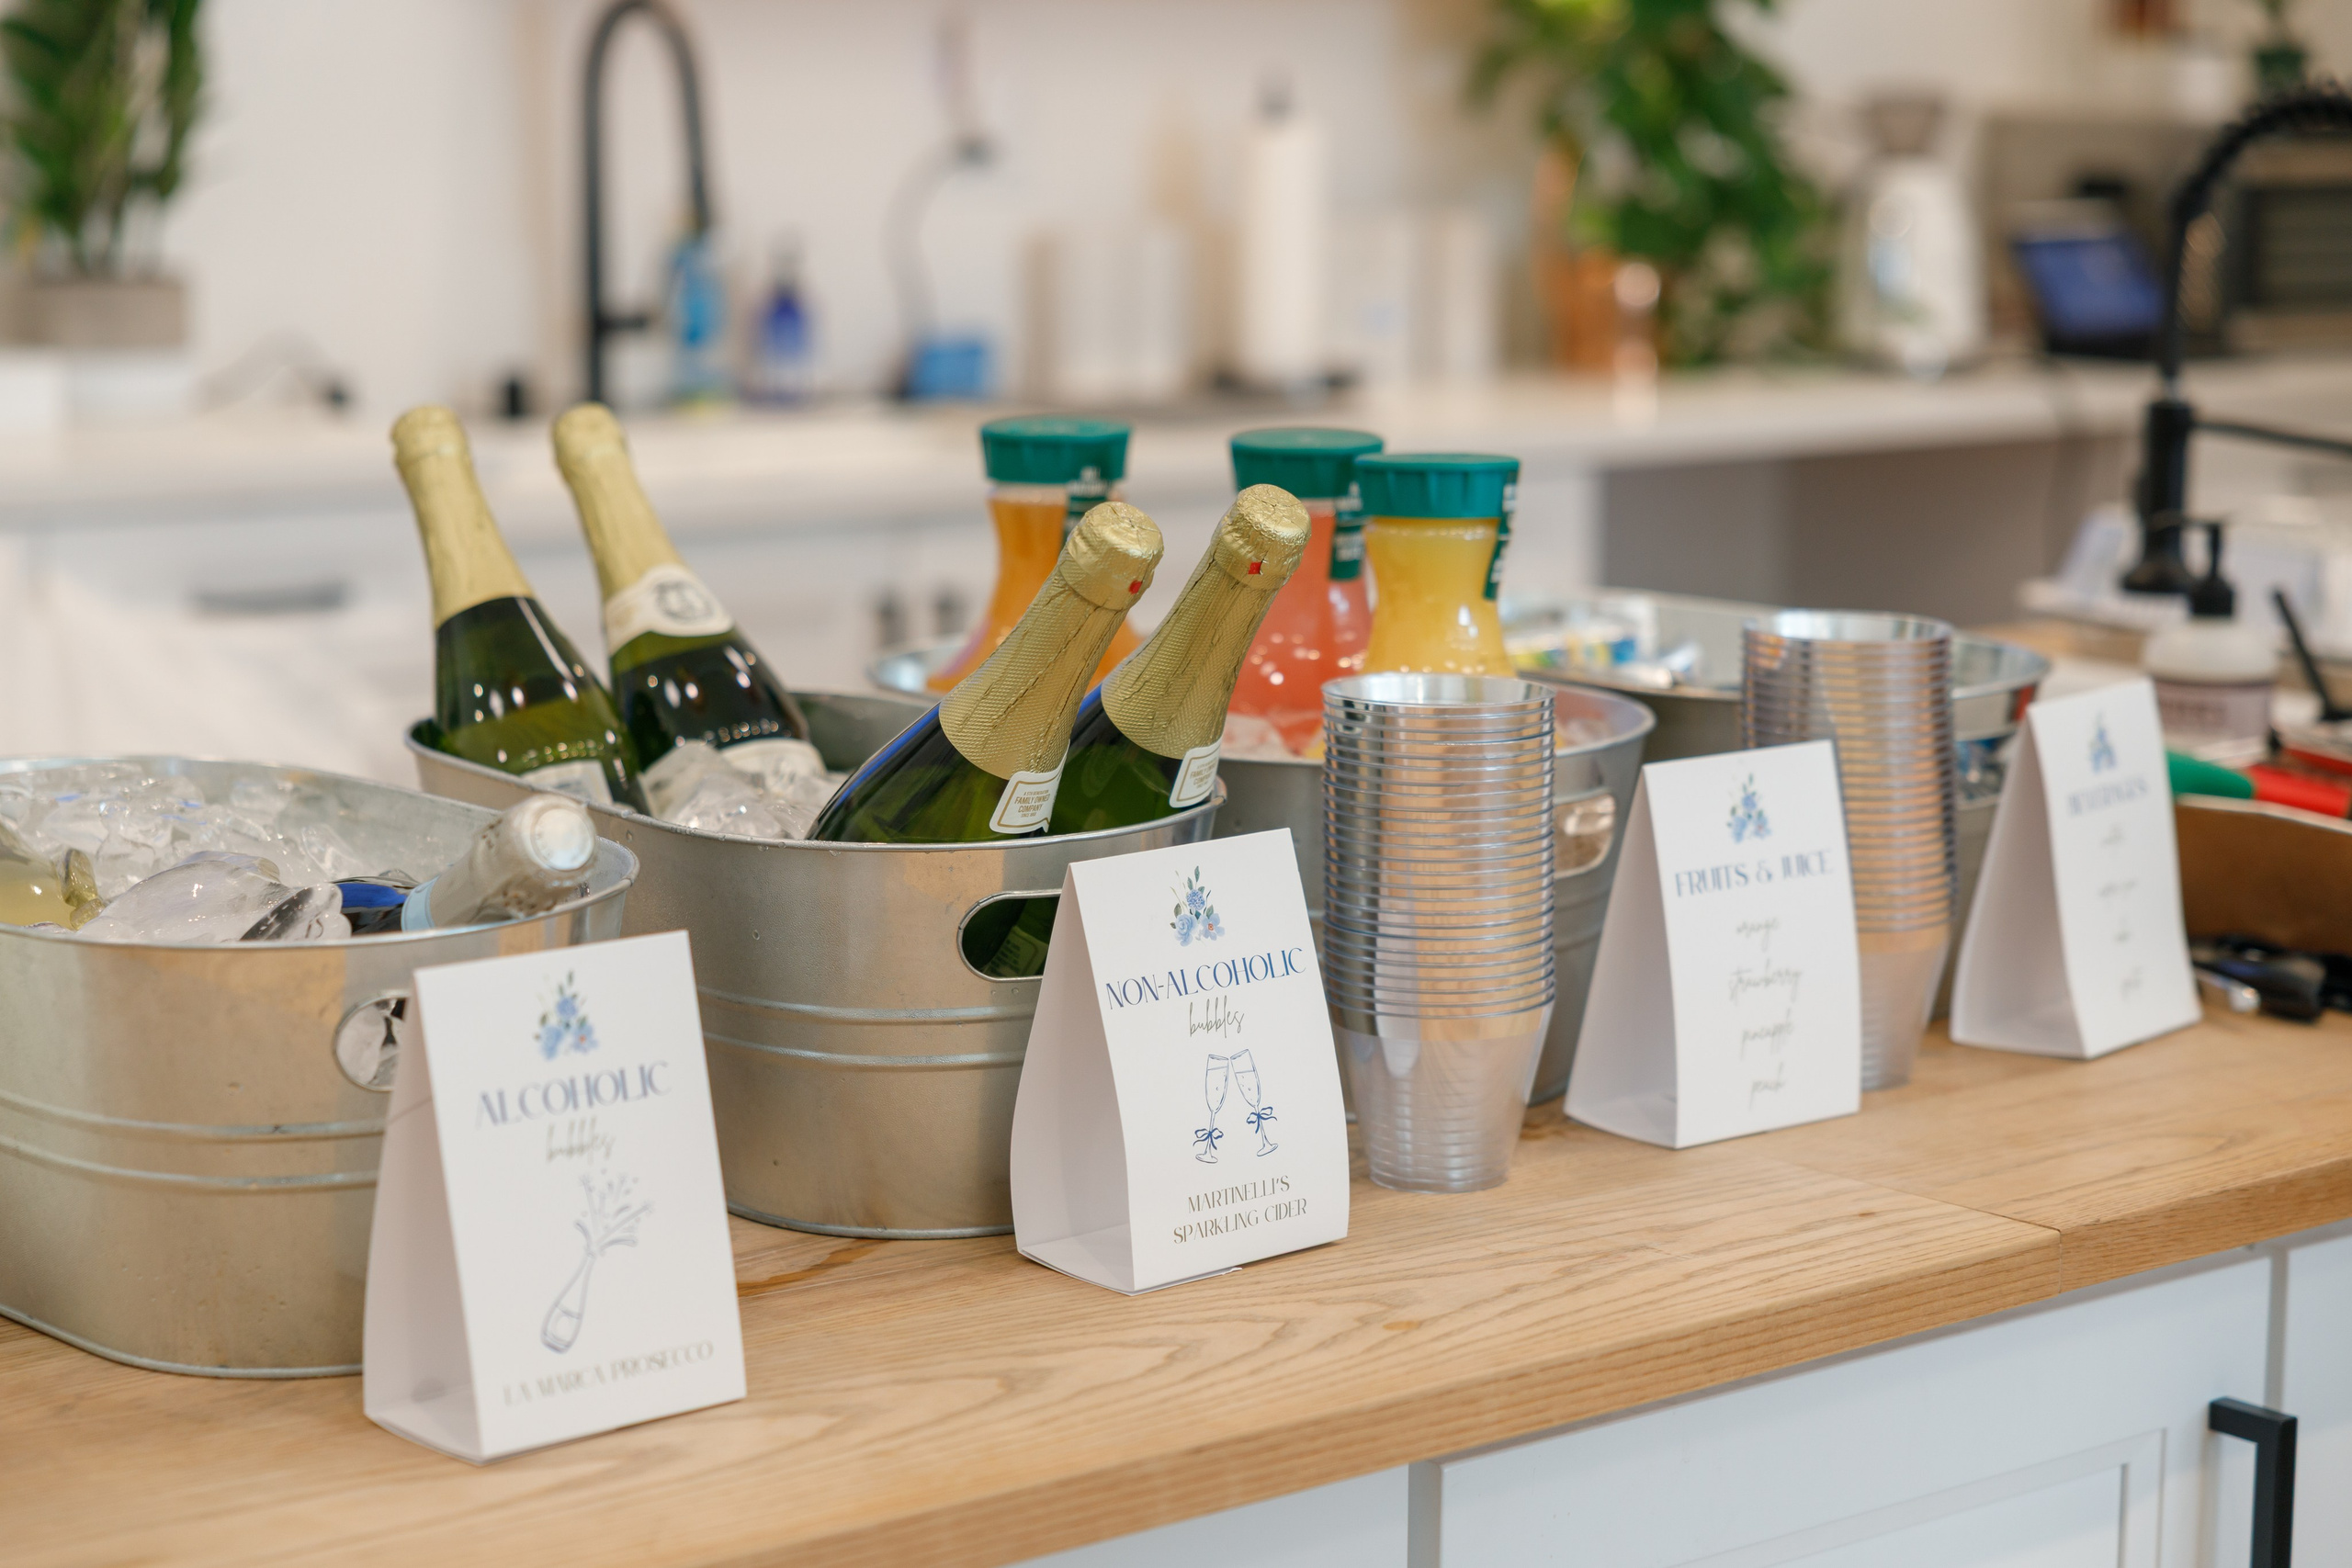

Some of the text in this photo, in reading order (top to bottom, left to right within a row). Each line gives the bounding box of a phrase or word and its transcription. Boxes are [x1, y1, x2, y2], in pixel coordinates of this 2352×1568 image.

[1014, 794, 1051, 805] FAMILY OWNED
[1018, 804, 1044, 813] COMPANY
[1674, 849, 1834, 897] FRUITS & JUICE
[1105, 947, 1306, 1010] NON-ALCOHOLIC
[1188, 995, 1245, 1039] bubbles
[474, 1059, 673, 1130] ALCOHOLIC
[546, 1115, 616, 1165] bubbles
[1188, 1175, 1291, 1214] MARTINELLI'S
[1173, 1198, 1307, 1244] SPARKLING CIDER
[503, 1381, 533, 1407] LA
[608, 1339, 715, 1382] PROSECCO
